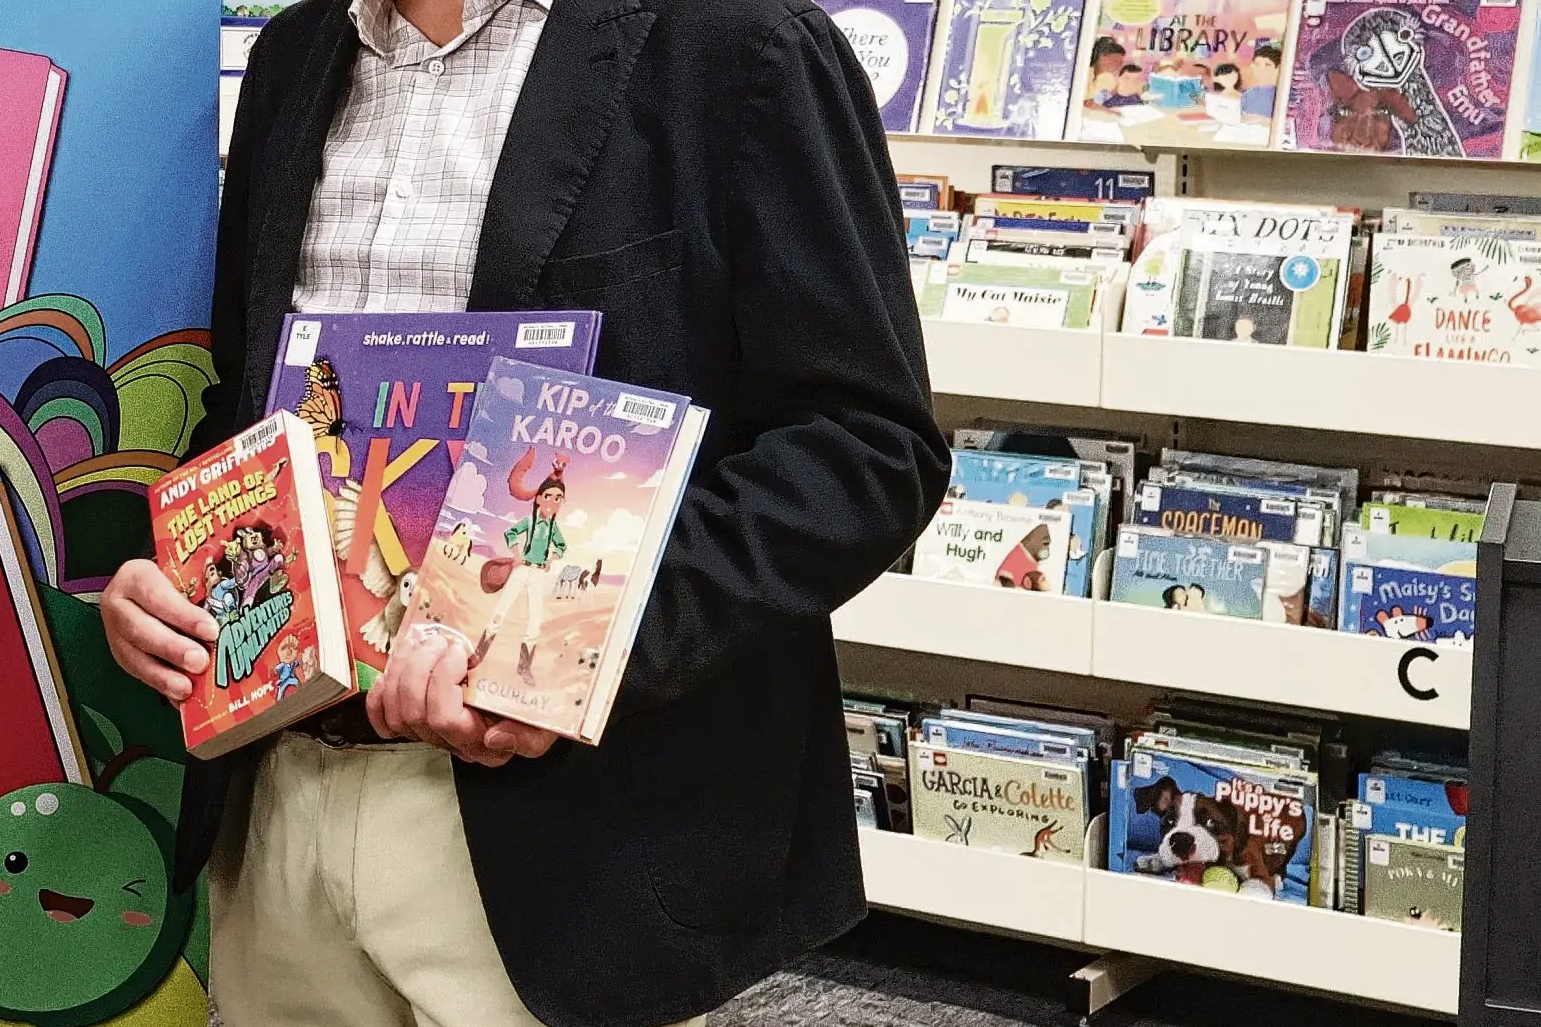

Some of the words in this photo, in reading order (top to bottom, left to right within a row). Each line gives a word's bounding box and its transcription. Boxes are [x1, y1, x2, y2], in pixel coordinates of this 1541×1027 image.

[1194, 14, 1217, 28] THE
[1134, 26, 1250, 54] LIBRARY
[1420, 3, 1502, 108] Grandfather
[1446, 83, 1486, 126] Emu
[955, 287, 976, 302] My
[981, 289, 1006, 302] Cat
[1013, 291, 1062, 306] Maisie
[1435, 307, 1491, 333] DANCE
[372, 381, 421, 428] IN
[536, 382, 590, 416] KIP
[589, 398, 605, 417] of
[603, 402, 618, 418] th
[510, 414, 627, 464] KAROO
[160, 474, 197, 509] ANDY
[167, 504, 199, 541] THE
[198, 479, 241, 516] LAND
[243, 469, 266, 491] OF
[174, 516, 215, 564] LOST
[215, 482, 278, 528] THINGS
[936, 523, 971, 542] Willy
[974, 529, 1004, 543] and
[946, 543, 986, 562] Hugh
[1378, 578, 1452, 605] Maisy's
[216, 591, 293, 688] ADVENTURES
[229, 608, 290, 681] UNLIMITED
[1397, 646, 1440, 701] C
[228, 696, 251, 714] BILL
[251, 681, 274, 702] HOPE
[922, 770, 994, 801] GARCIA
[994, 784, 1003, 799] &
[1004, 780, 1076, 812] Colette
[1215, 780, 1303, 818] Puppy's
[1232, 777, 1253, 794] It's
[972, 801, 1050, 824] EXPLORING
[1249, 814, 1295, 842] Life
[1394, 821, 1448, 845] THE
